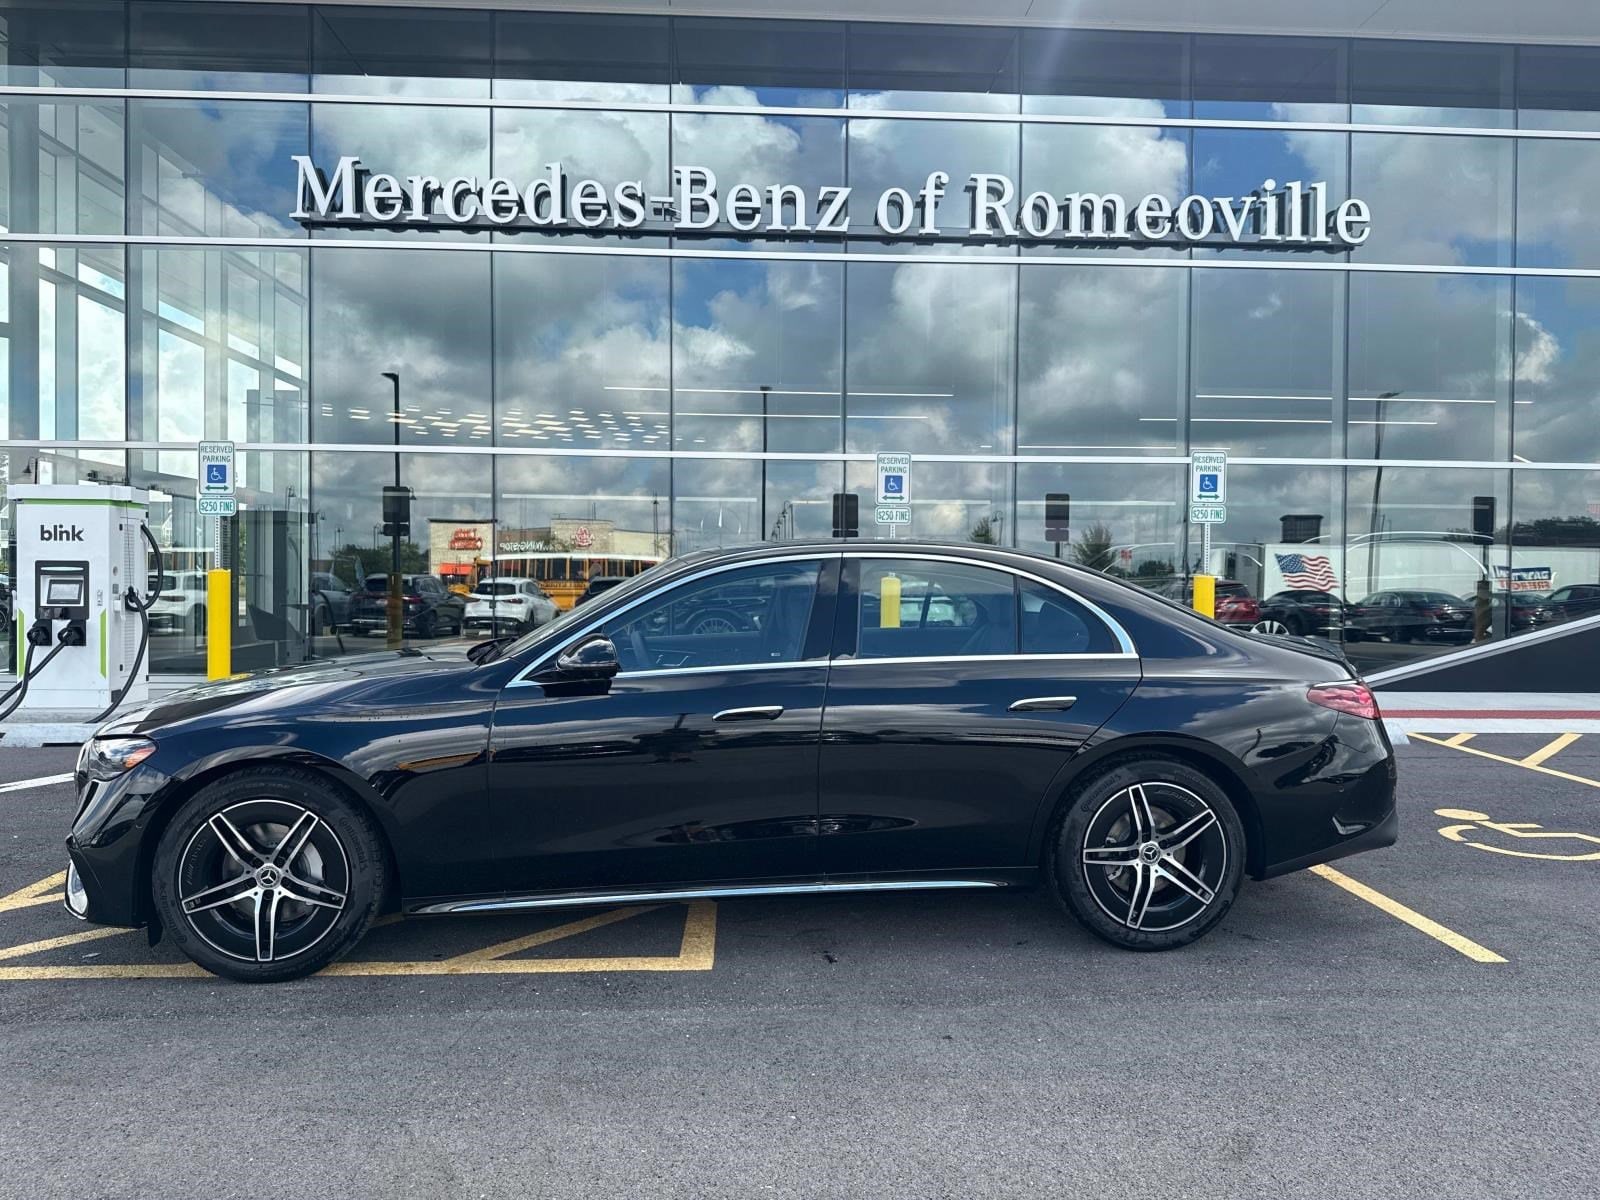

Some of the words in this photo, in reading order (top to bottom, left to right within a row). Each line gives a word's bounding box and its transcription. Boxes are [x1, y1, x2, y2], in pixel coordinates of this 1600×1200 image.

[289, 154, 852, 232] Mercedes-Benz
[876, 171, 949, 236] of
[968, 173, 1371, 244] Romeoville
[200, 446, 233, 454] RESERVED
[202, 455, 231, 463] PARKING
[879, 457, 909, 465] RESERVED
[1193, 456, 1224, 464] RESERVED
[880, 466, 907, 474] PARKING
[1195, 465, 1222, 473] PARKING
[200, 501, 218, 512] $250
[219, 501, 233, 512] FINE
[878, 510, 894, 521] $250
[895, 510, 909, 521] FINE
[1193, 509, 1209, 519] $250
[1210, 509, 1224, 519] FINE
[40, 524, 84, 541] blink
